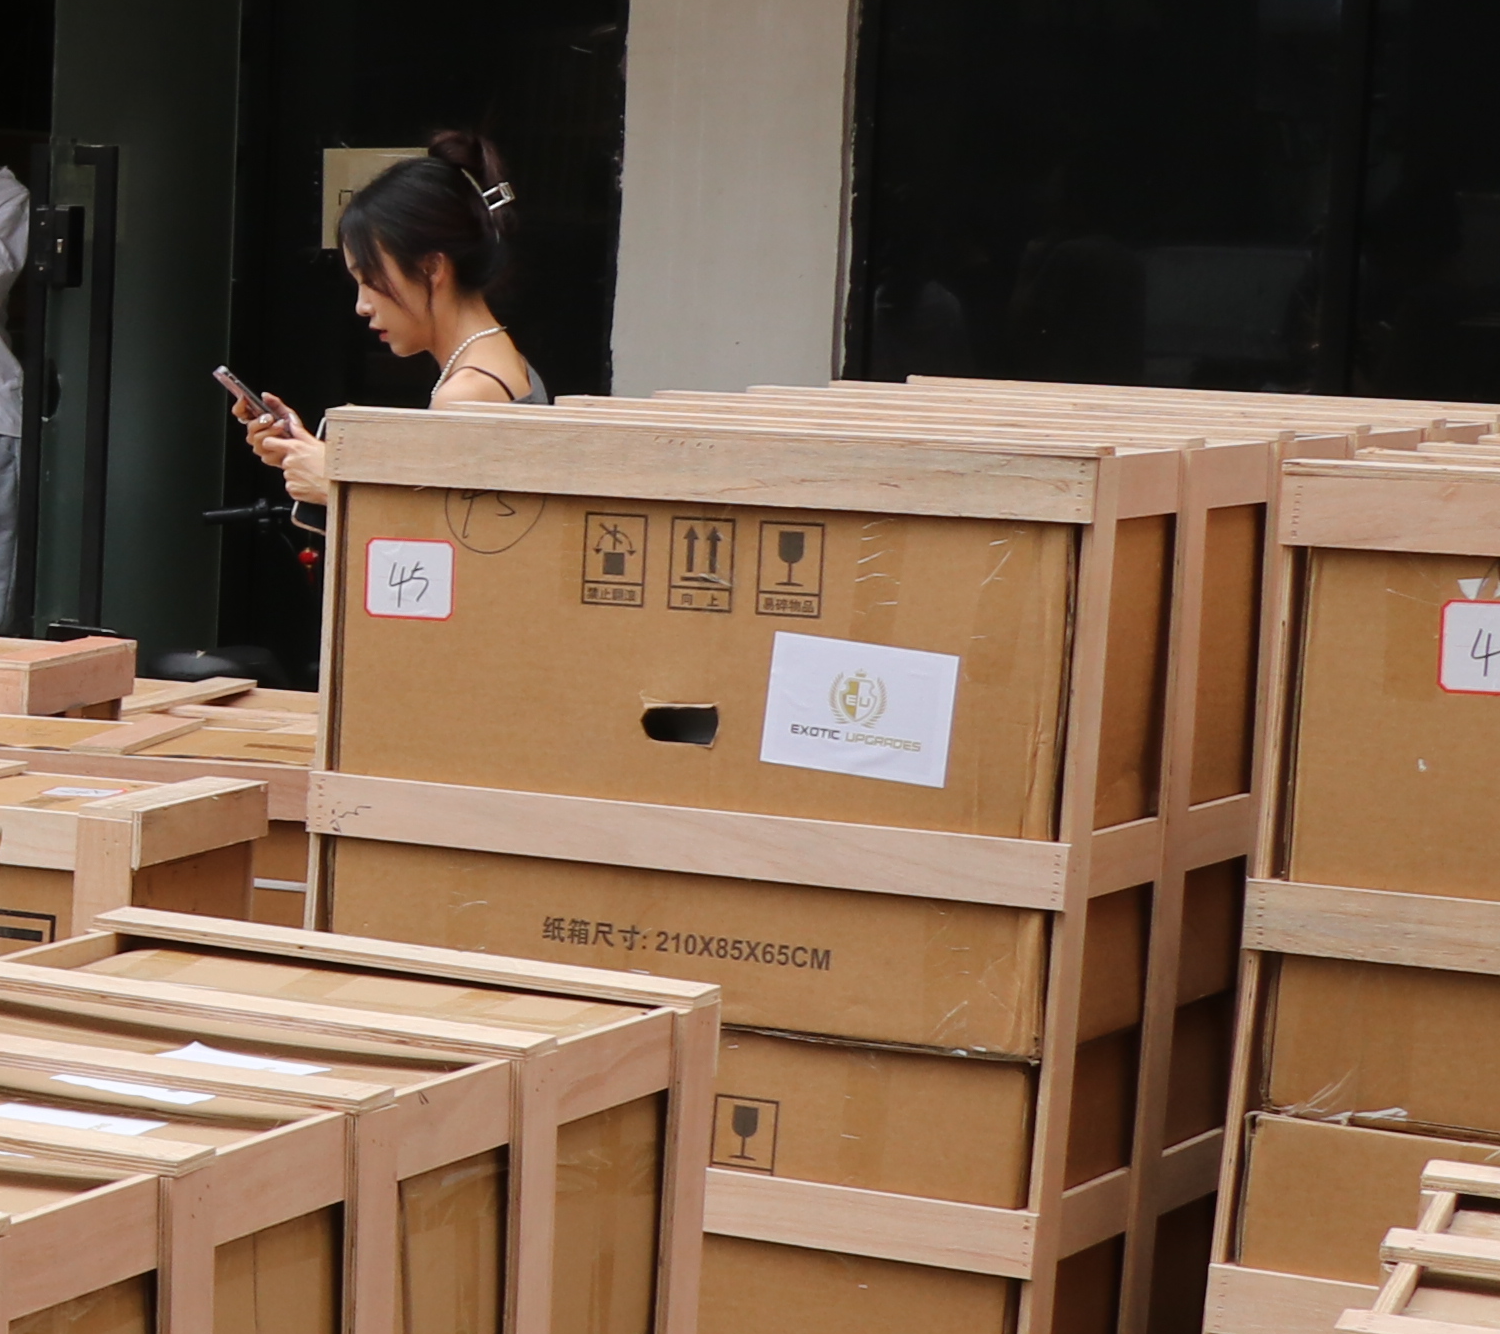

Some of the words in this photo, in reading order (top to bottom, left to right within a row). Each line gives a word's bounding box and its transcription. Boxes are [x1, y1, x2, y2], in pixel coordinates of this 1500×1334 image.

[389, 561, 429, 608] 45
[790, 723, 841, 740] EXOTIC
[845, 732, 922, 752] UPGRADES
[655, 931, 831, 971] 210X85X65CM
